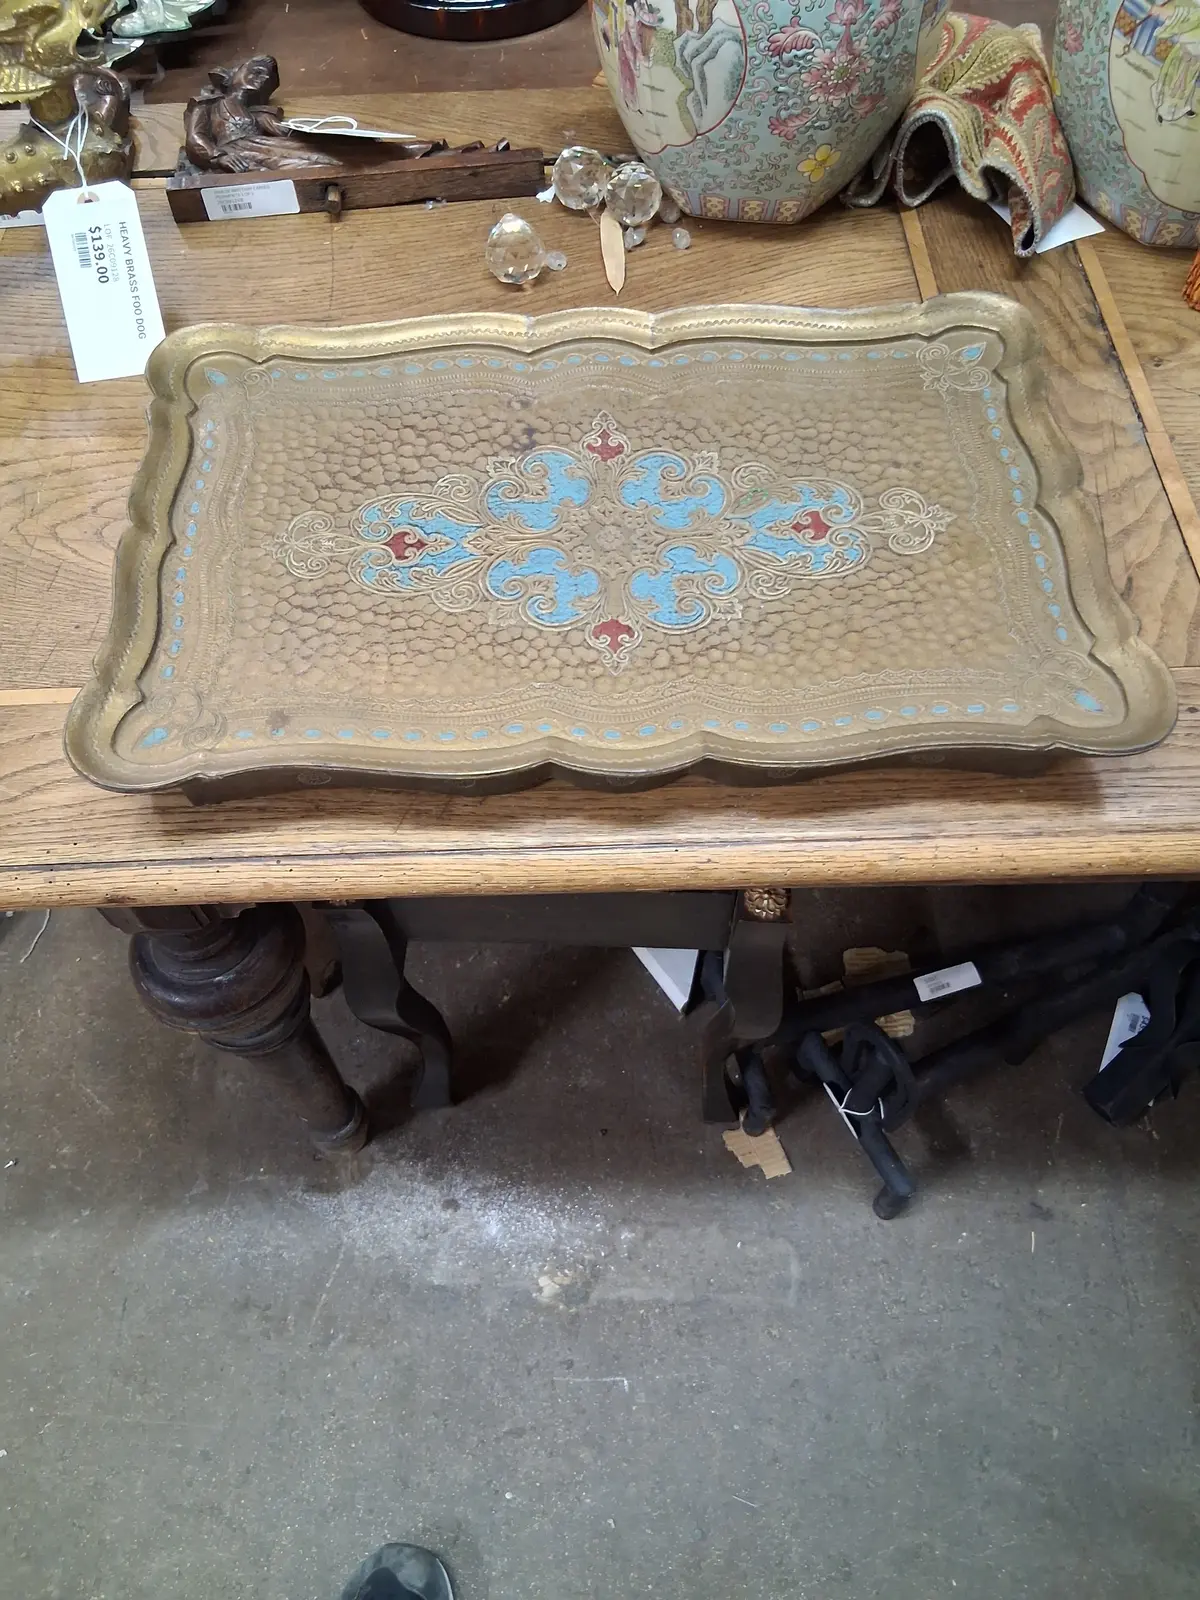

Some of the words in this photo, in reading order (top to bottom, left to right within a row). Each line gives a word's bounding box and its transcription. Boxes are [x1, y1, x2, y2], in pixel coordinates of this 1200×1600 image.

[88, 225, 110, 284] $139.00
[119, 221, 132, 256] HEAVY
[106, 243, 120, 283] 26C09128
[125, 258, 139, 293] BRASS
[131, 295, 142, 316] FOO
[135, 318, 147, 340] DOG
